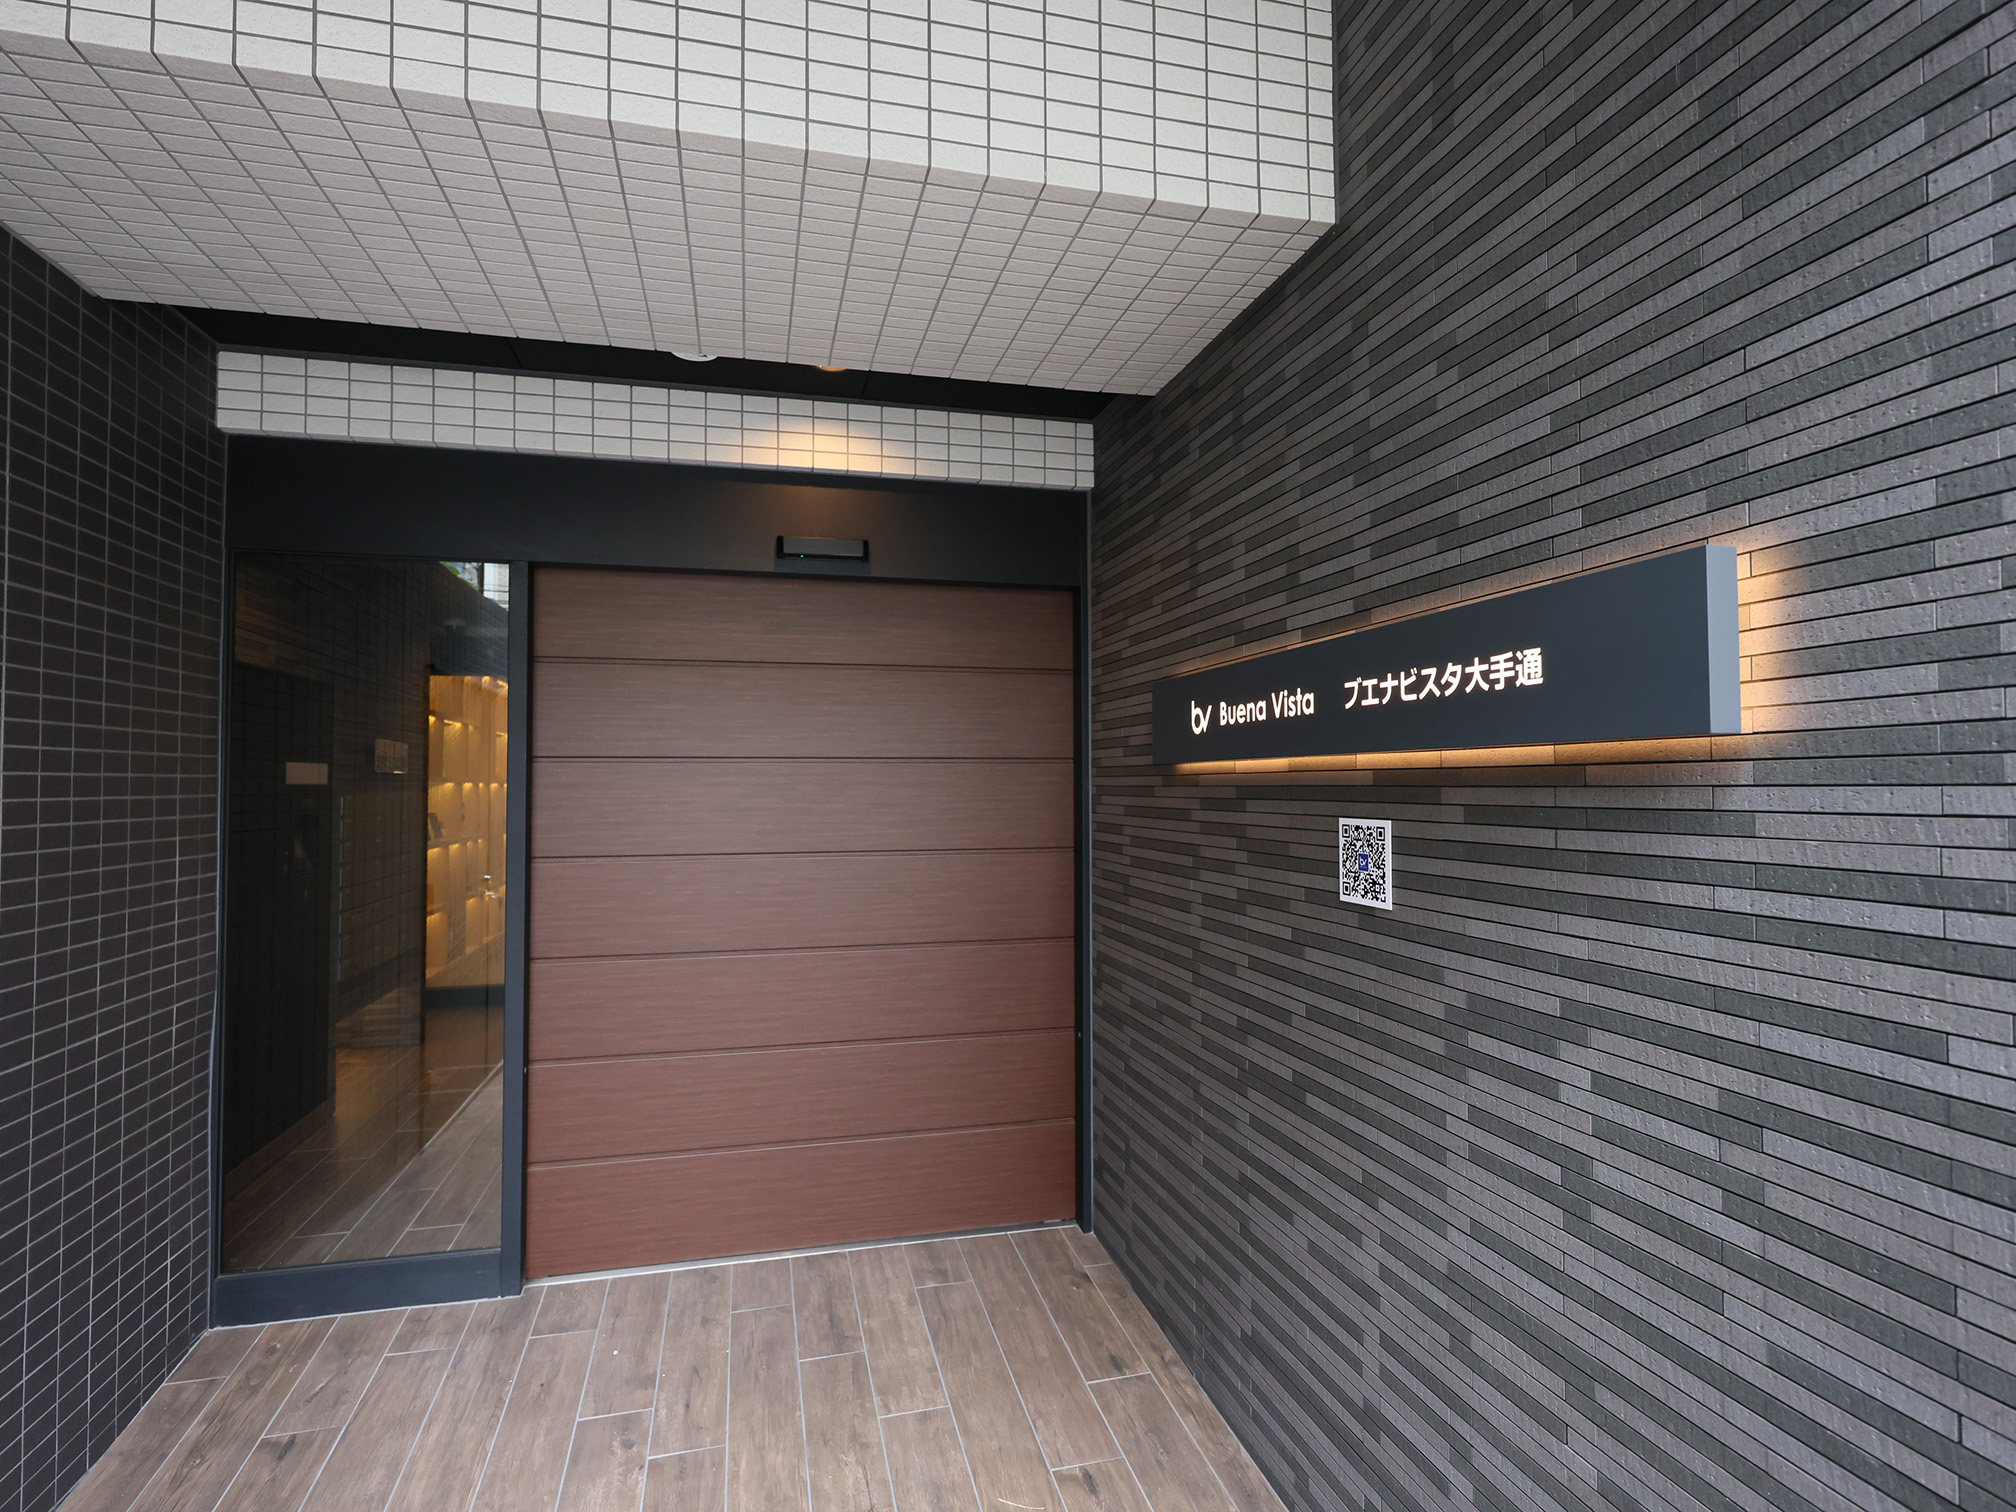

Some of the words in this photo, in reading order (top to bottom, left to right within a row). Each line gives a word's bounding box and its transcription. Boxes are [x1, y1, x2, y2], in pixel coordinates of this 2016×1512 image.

[1344, 648, 1543, 709] ブエナビスタ大手通
[1220, 701, 1266, 726] Buena
[1271, 688, 1314, 719] Vista
